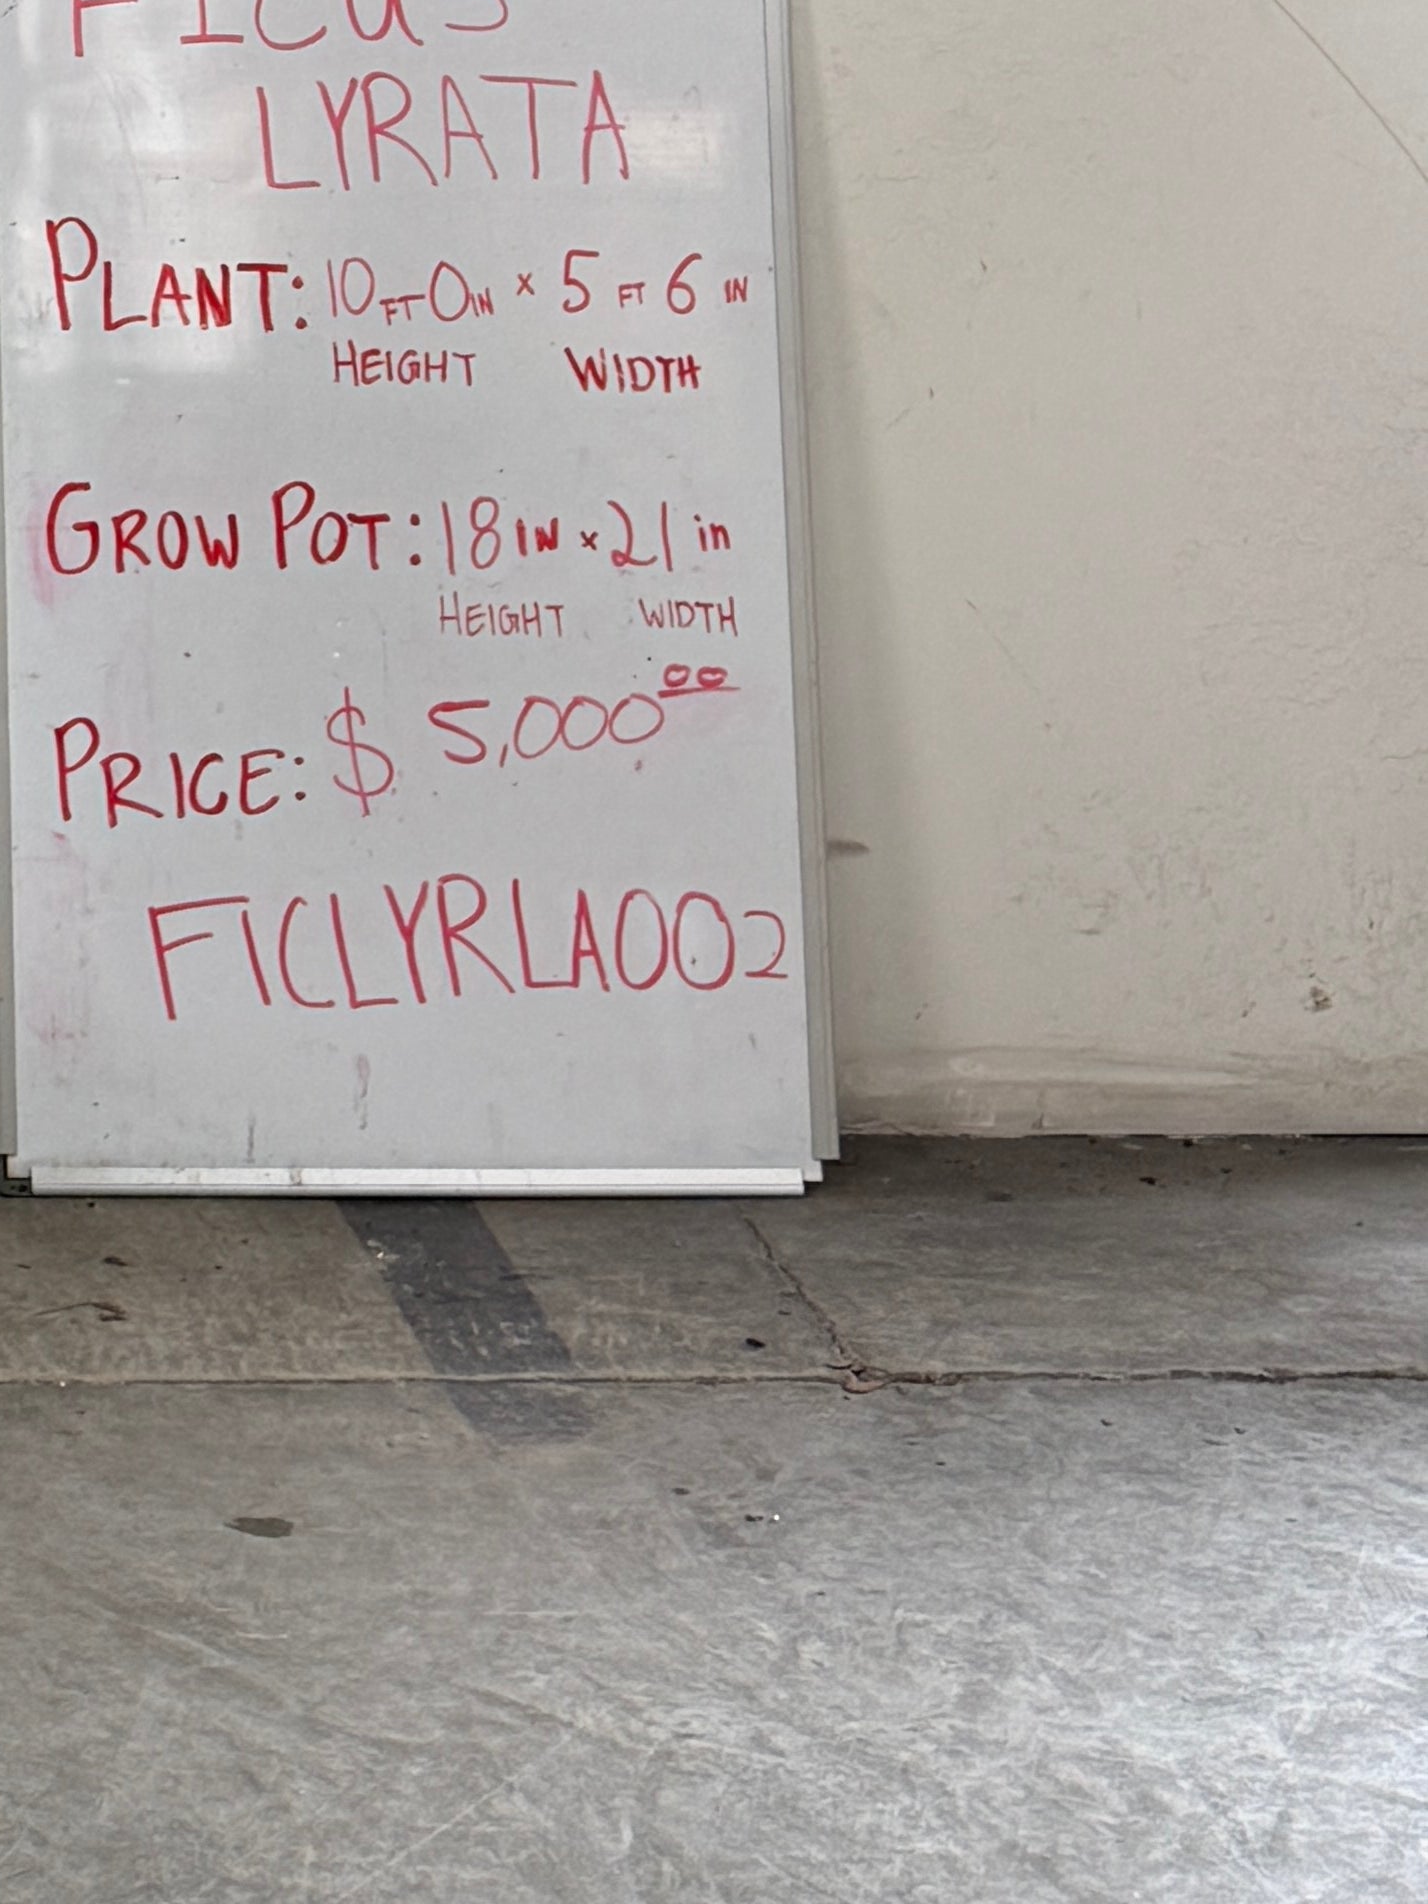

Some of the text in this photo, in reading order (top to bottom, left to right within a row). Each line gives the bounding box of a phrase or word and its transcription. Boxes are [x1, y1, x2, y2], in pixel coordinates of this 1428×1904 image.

[254, 69, 631, 192] LYRATA
[43, 216, 308, 335] PLANT:
[332, 338, 702, 395] HEIGHT WIDTH
[42, 480, 242, 578] GROW
[269, 479, 422, 573] POT:
[439, 590, 740, 639] HEIGHT WIDTH
[52, 715, 308, 830] PRICE:
[145, 872, 789, 1023] FICLYRLA002
